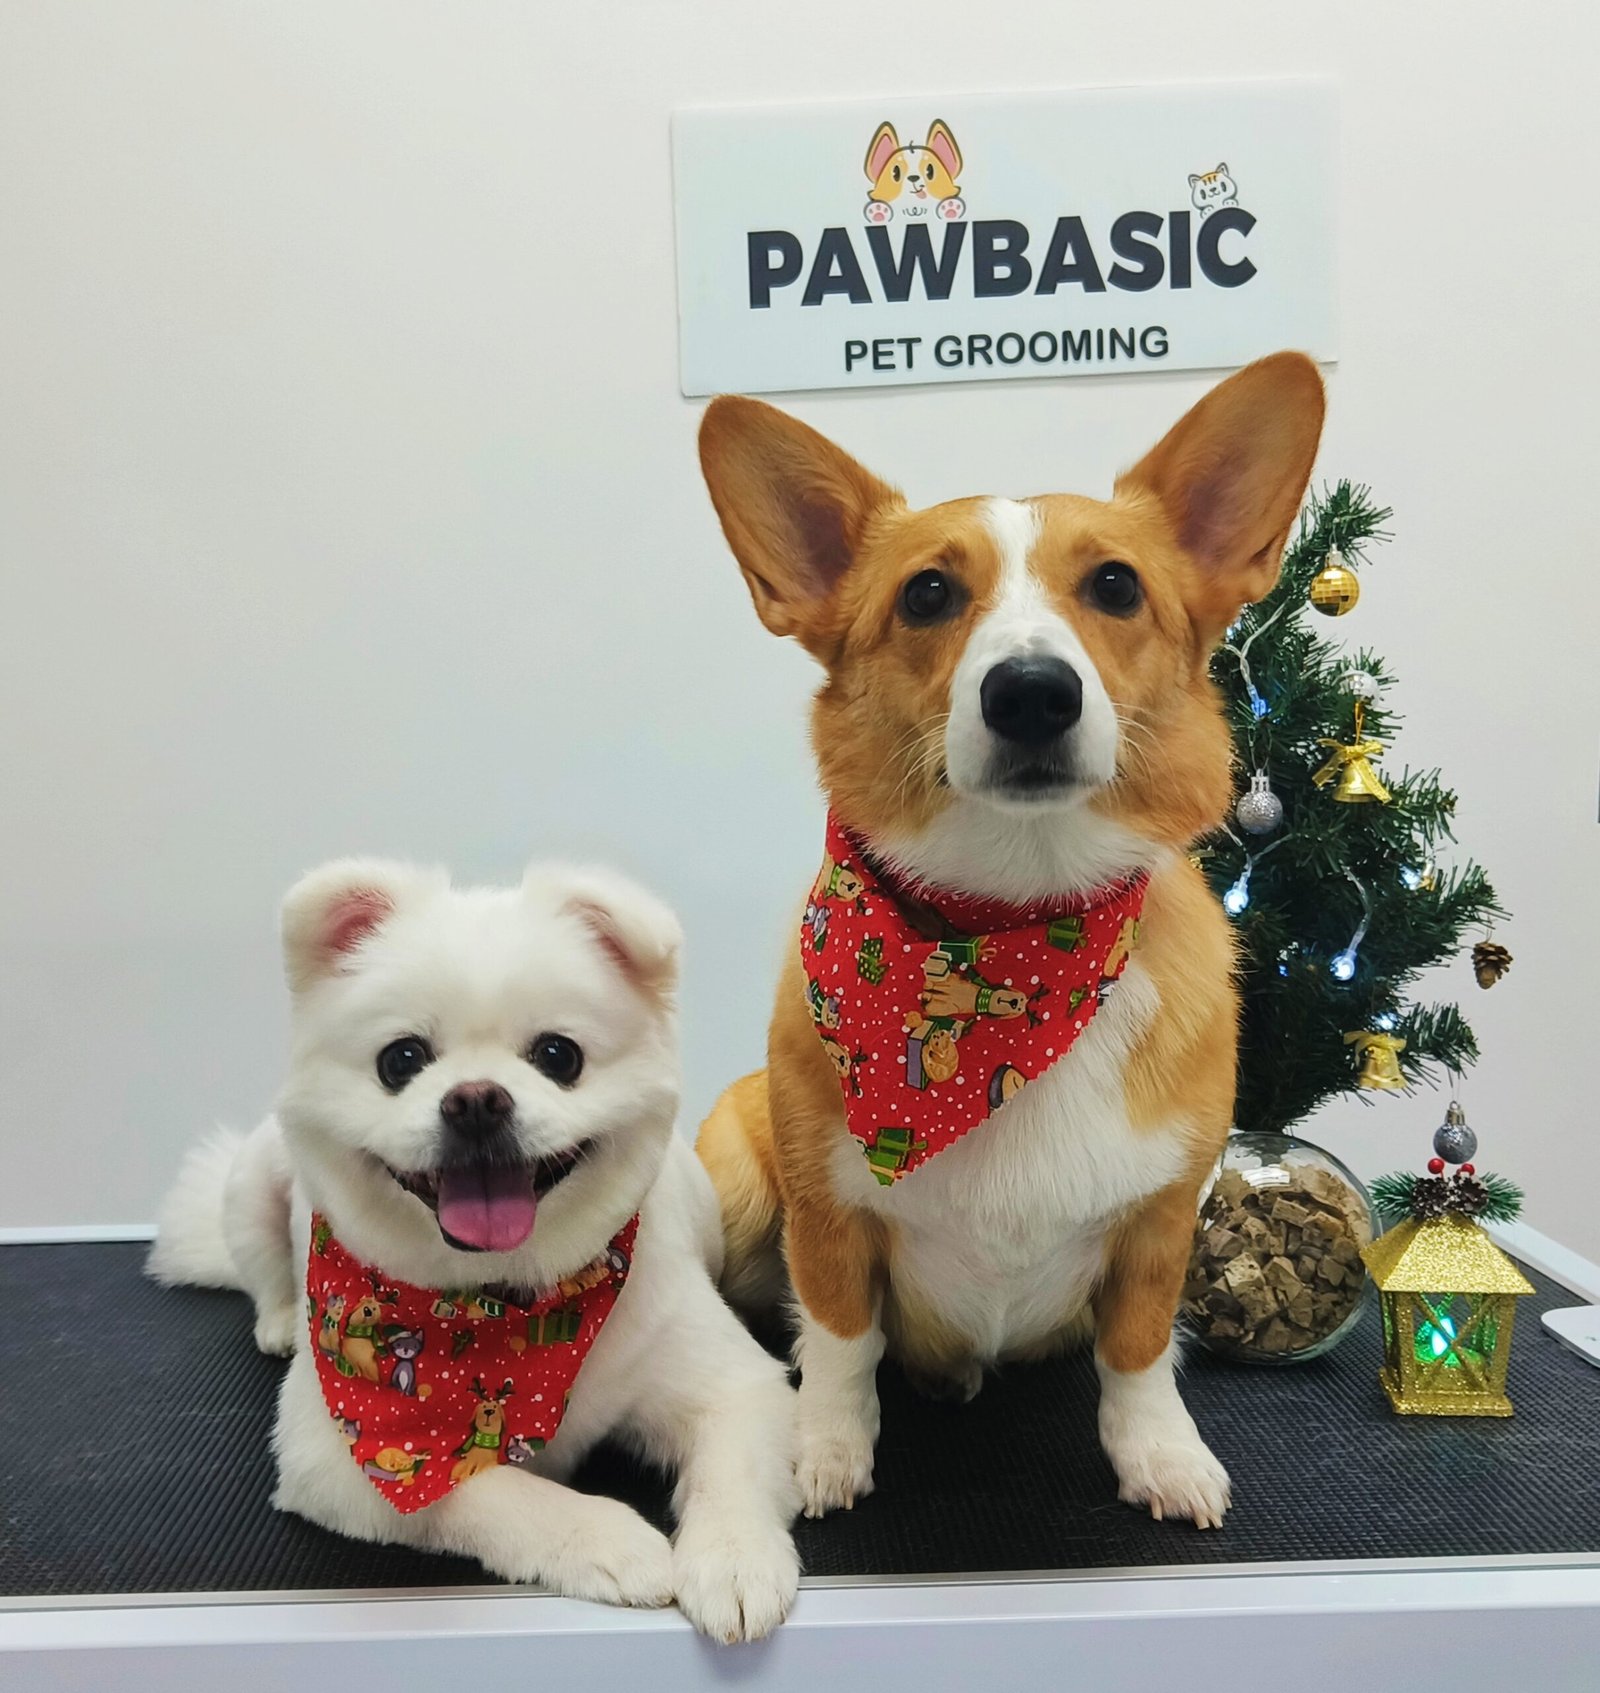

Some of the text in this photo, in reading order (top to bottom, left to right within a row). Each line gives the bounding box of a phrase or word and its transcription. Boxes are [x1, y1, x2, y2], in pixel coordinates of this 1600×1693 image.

[748, 207, 1258, 309] PAWBASIC
[845, 326, 1170, 372] PET GROOMING
